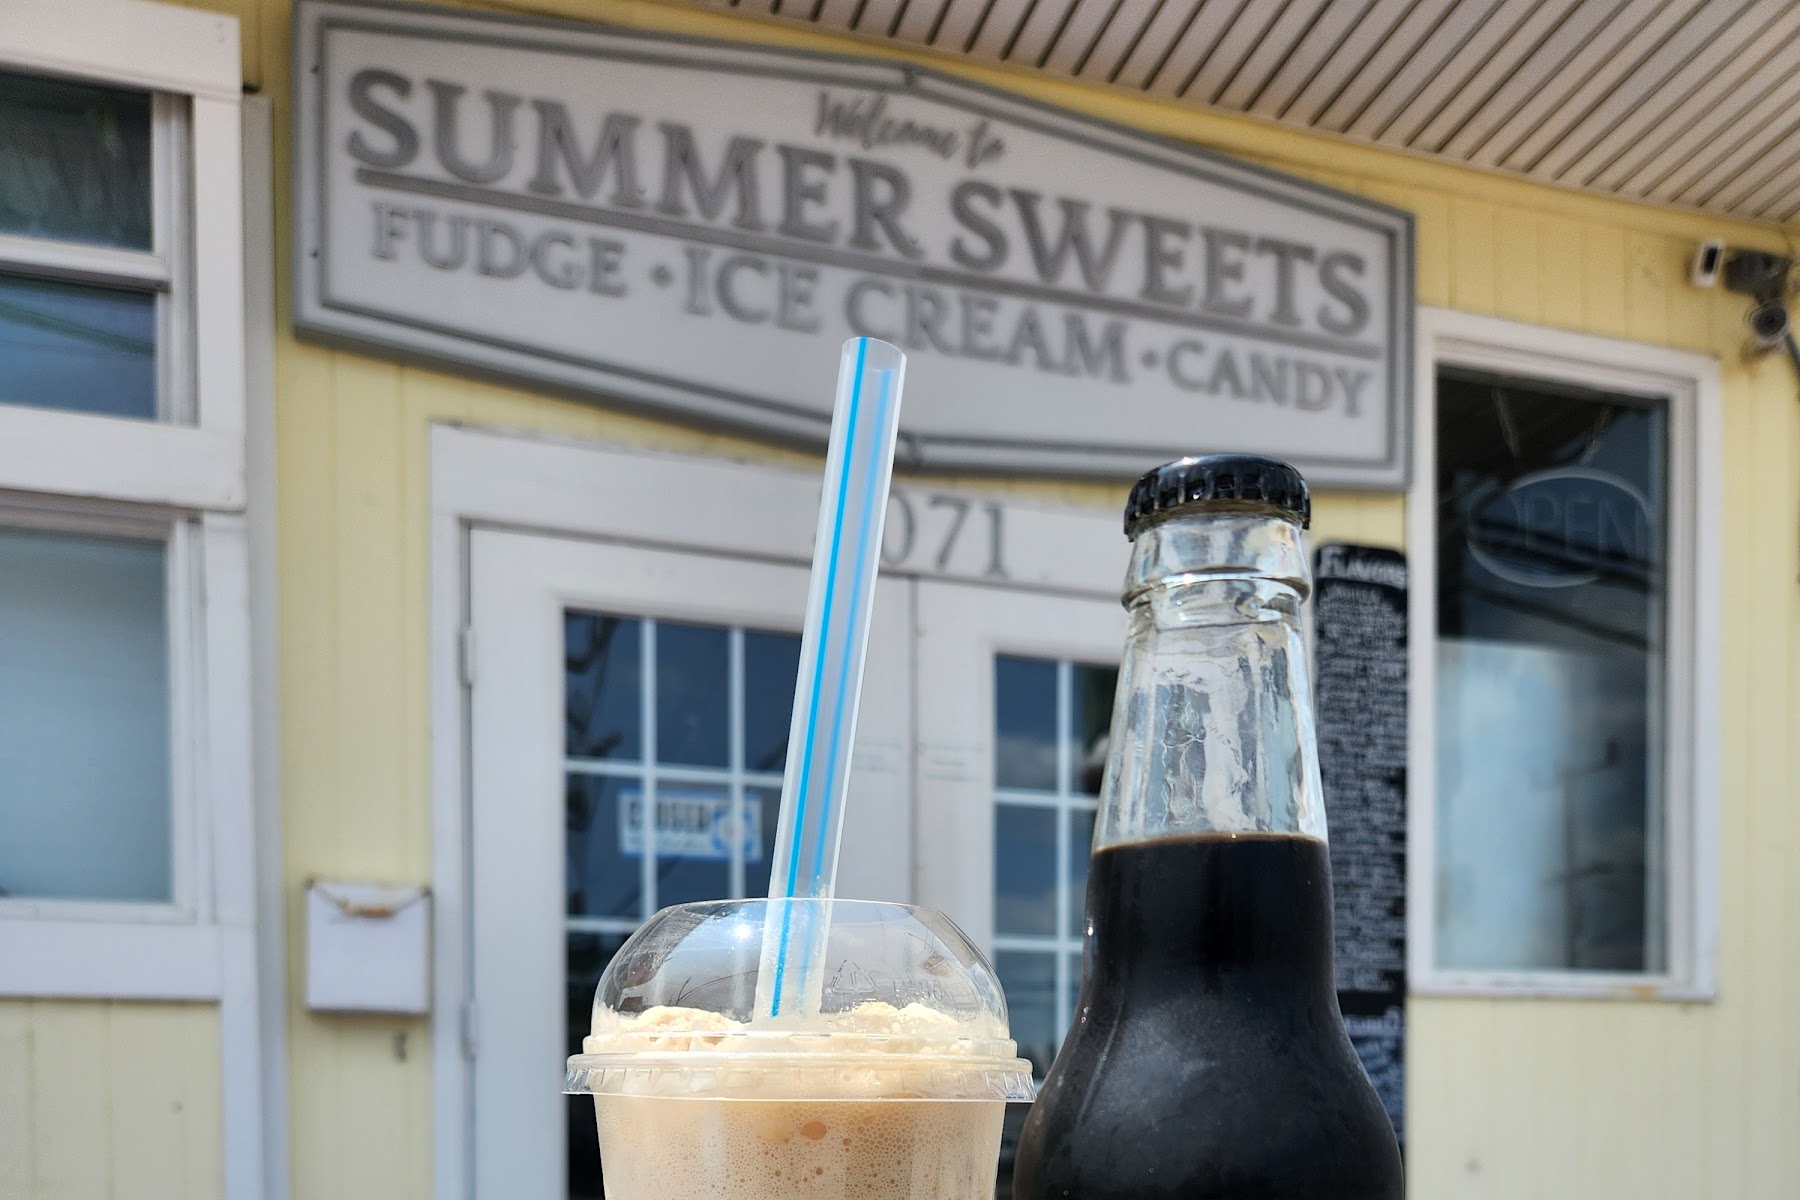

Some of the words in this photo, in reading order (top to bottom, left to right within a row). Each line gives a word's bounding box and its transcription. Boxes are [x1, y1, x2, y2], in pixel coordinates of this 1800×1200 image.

[347, 67, 926, 260] SUMMER
[949, 178, 1374, 337] SWEETS
[371, 201, 629, 299] FUDGE
[684, 246, 822, 335] ICE
[843, 277, 1134, 386] CREAM
[1167, 343, 1373, 418] CANDY
[818, 488, 1008, 578] 071
